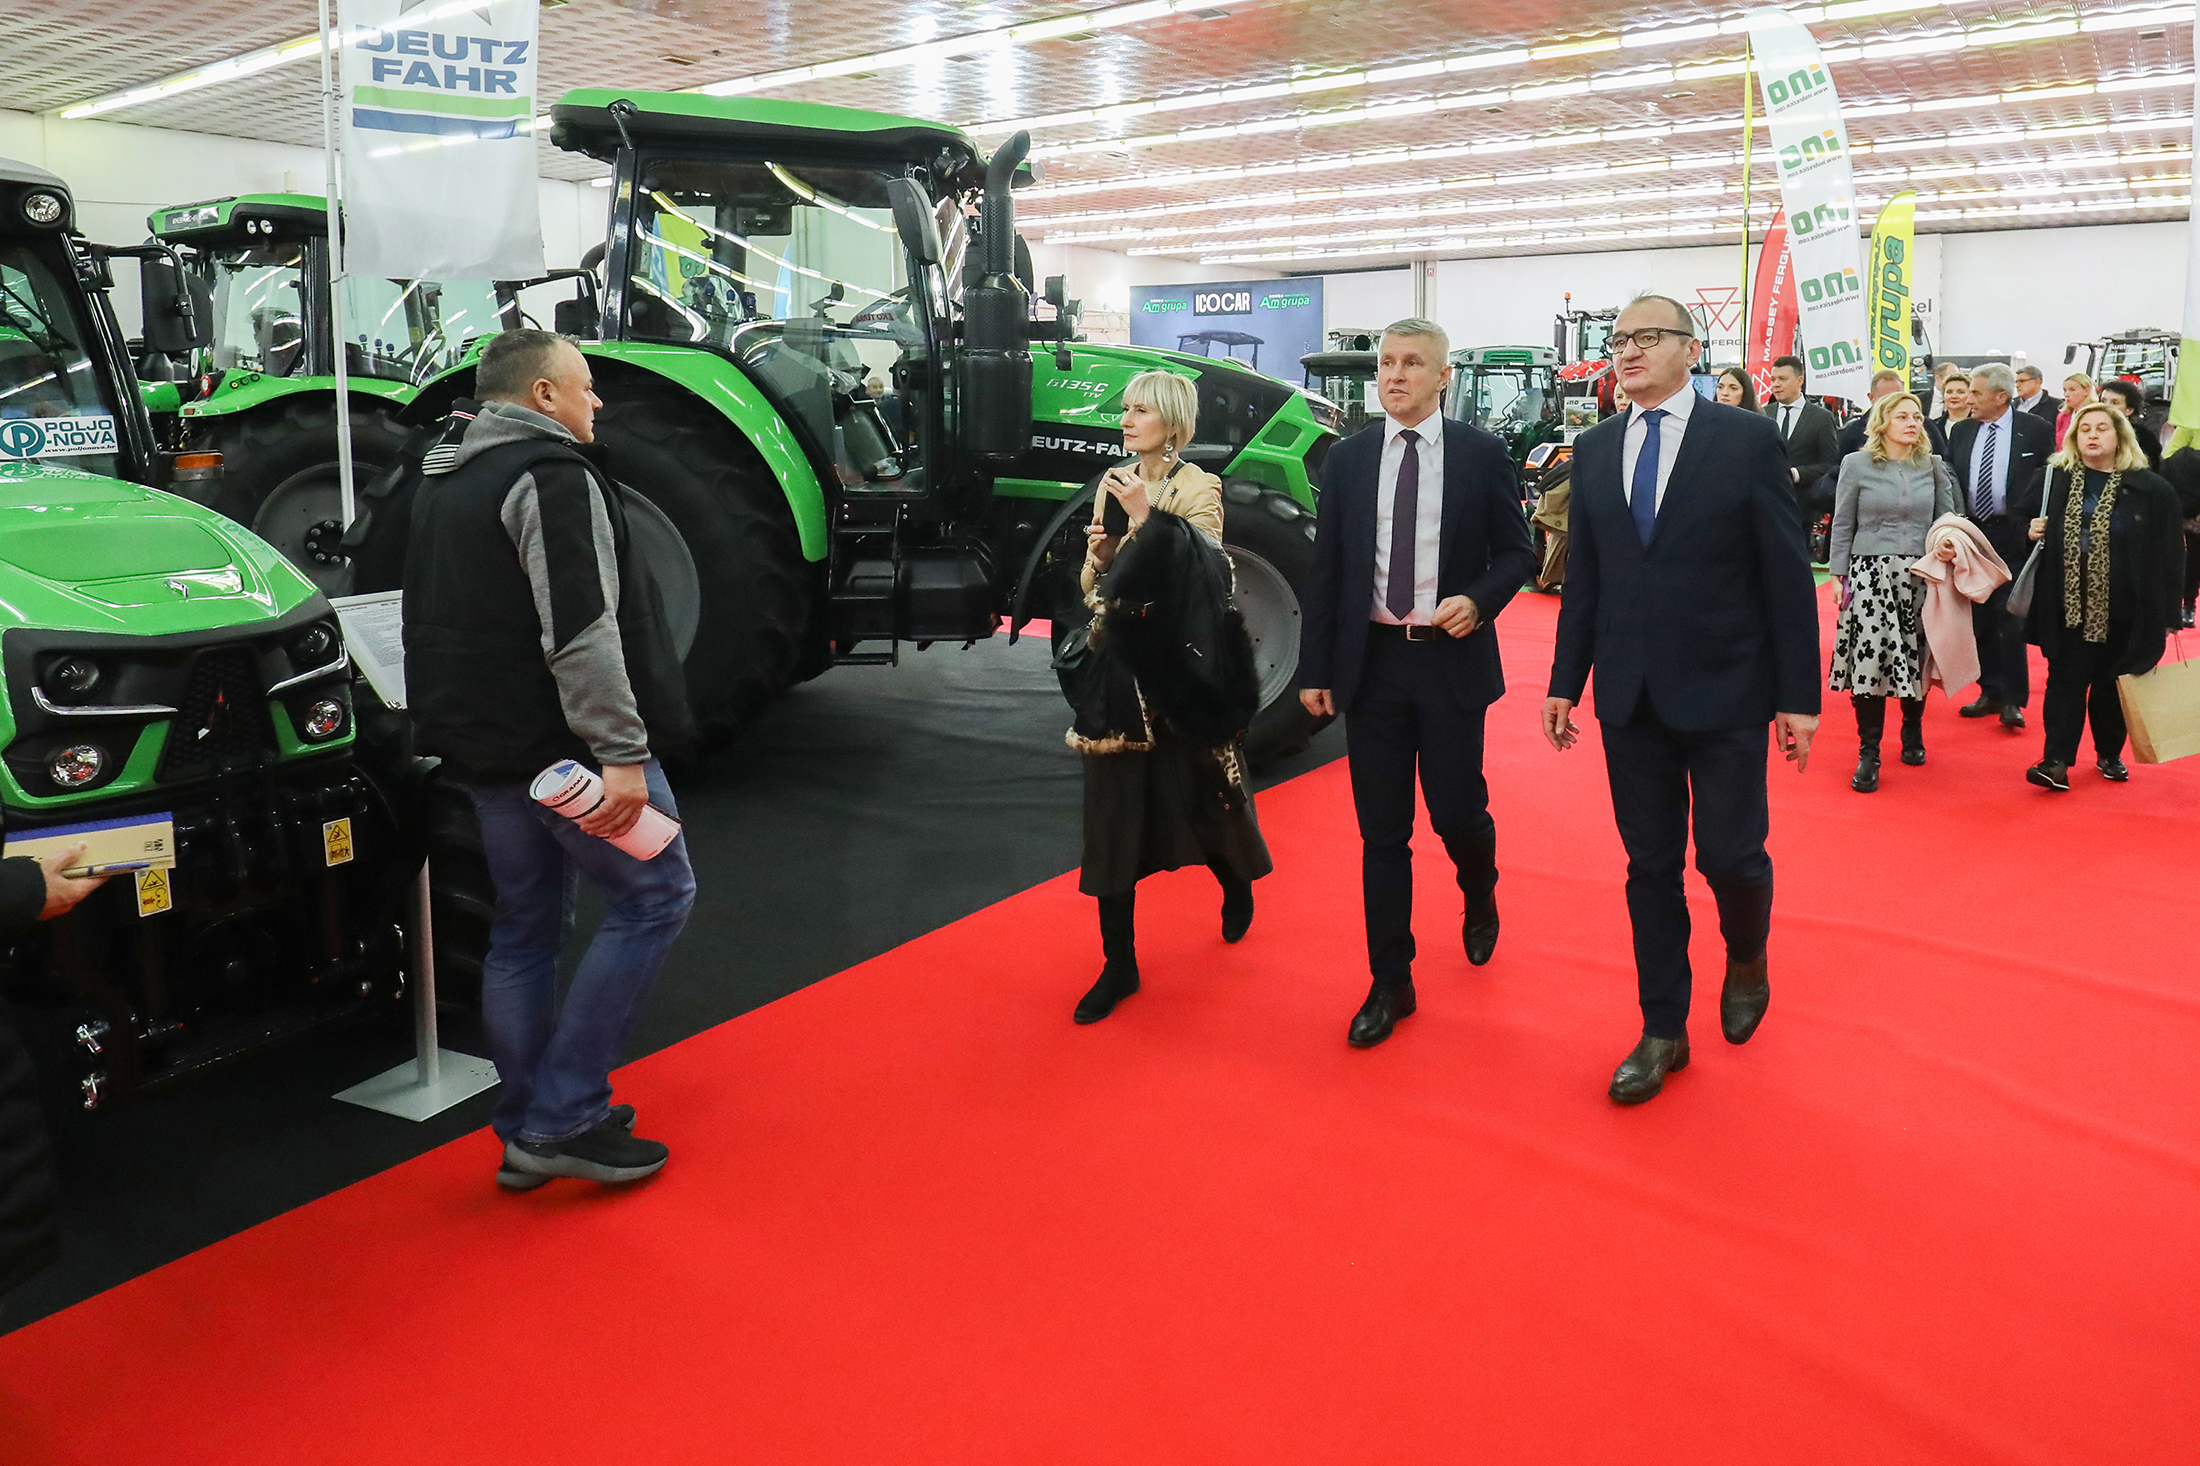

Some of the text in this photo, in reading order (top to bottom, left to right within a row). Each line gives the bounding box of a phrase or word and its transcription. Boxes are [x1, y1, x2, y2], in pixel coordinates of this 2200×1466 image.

[355, 24, 529, 65] DEUTZ
[372, 57, 518, 94] FAHR
[1161, 302, 1188, 313] grupa
[1195, 292, 1250, 313] ICOCAR
[1281, 296, 1311, 309] grupa
[1879, 235, 1909, 371] grupa
[1763, 296, 1779, 362] MASSEY
[1711, 338, 1749, 346] FERG
[44, 419, 113, 433] POLJO
[1032, 435, 1138, 458] EUTZ-FAH
